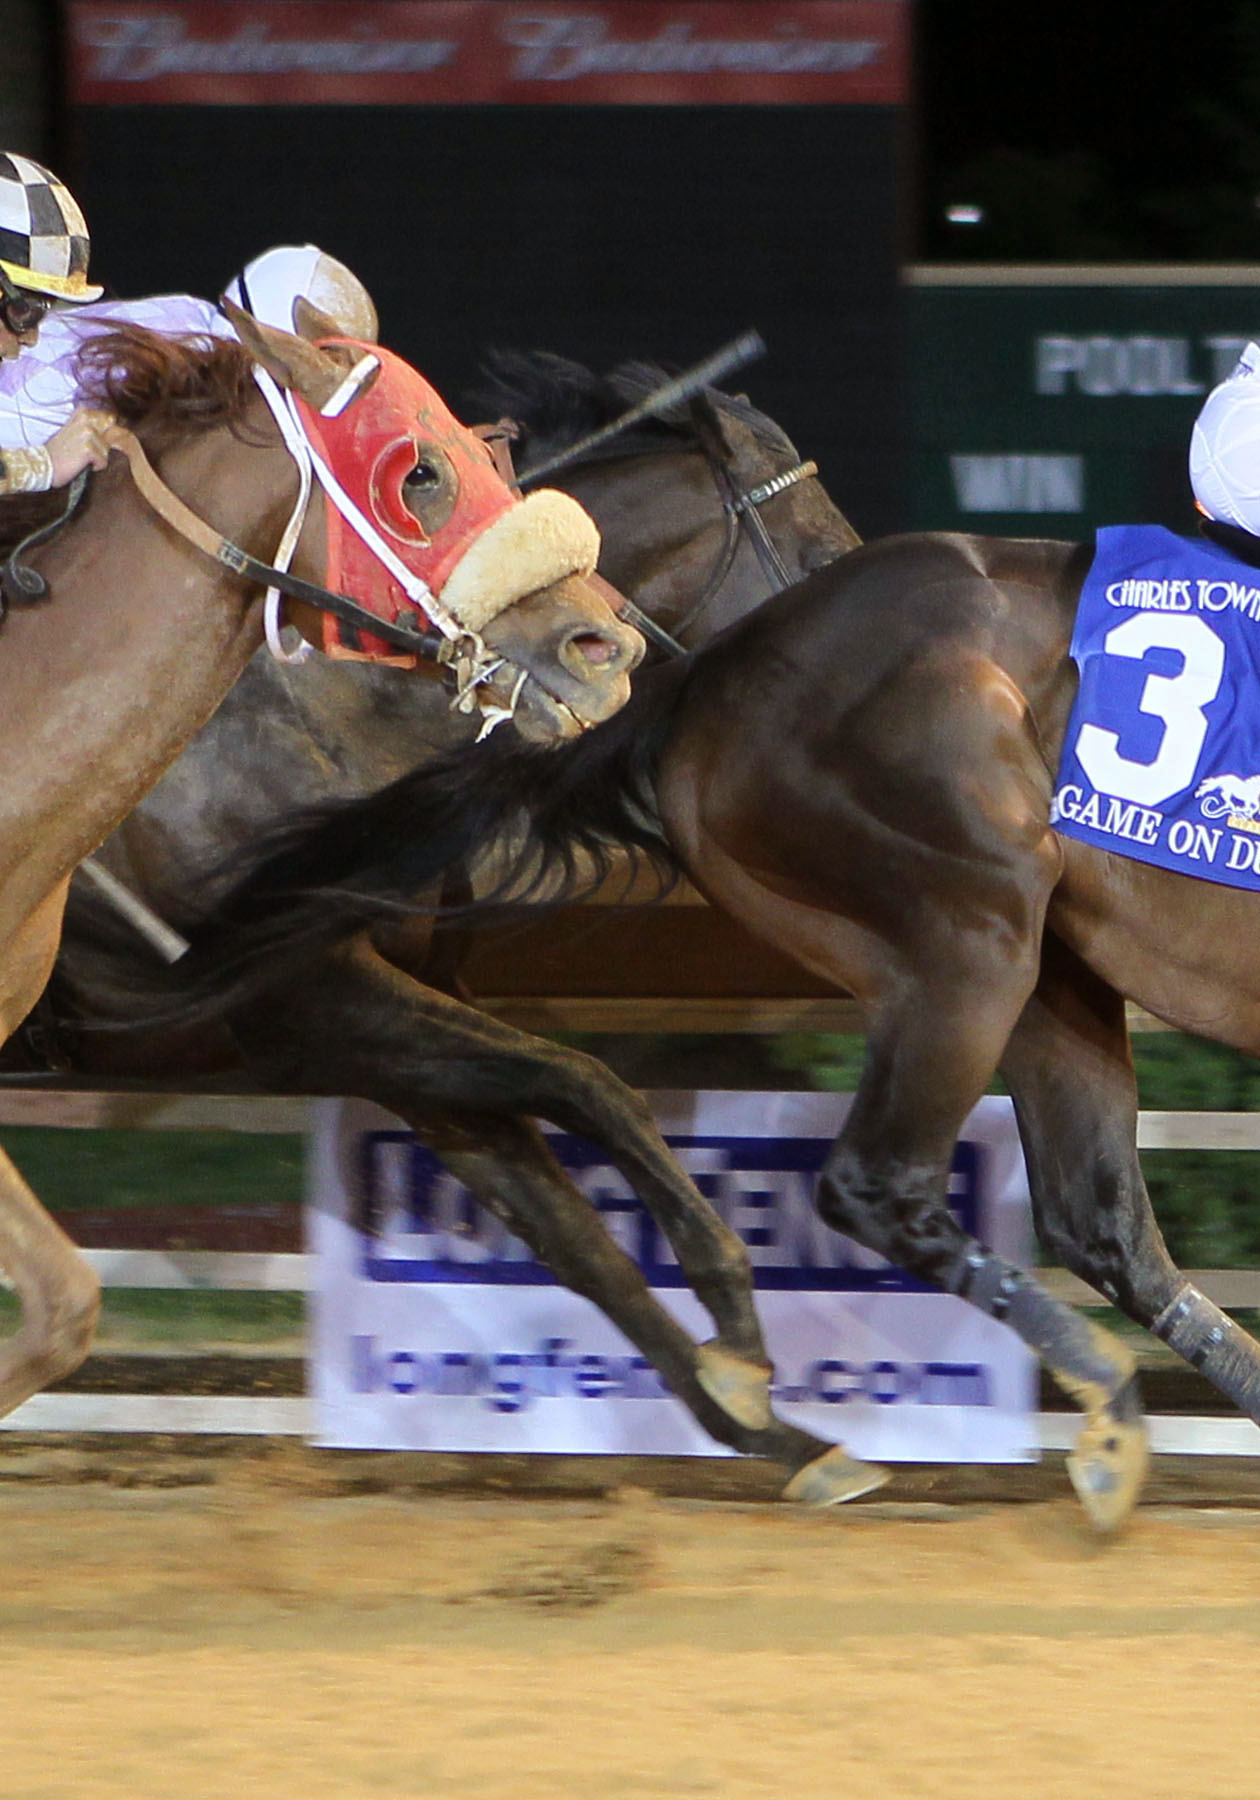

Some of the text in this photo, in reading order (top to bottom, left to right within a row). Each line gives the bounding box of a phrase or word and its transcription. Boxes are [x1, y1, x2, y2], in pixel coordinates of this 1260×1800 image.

[1035, 336, 1204, 396] POOL
[950, 455, 1085, 513] WIN
[1105, 578, 1193, 612] CHARLES
[1075, 611, 1226, 808] 3
[1056, 783, 1164, 846] GAME
[1167, 818, 1224, 864] ON
